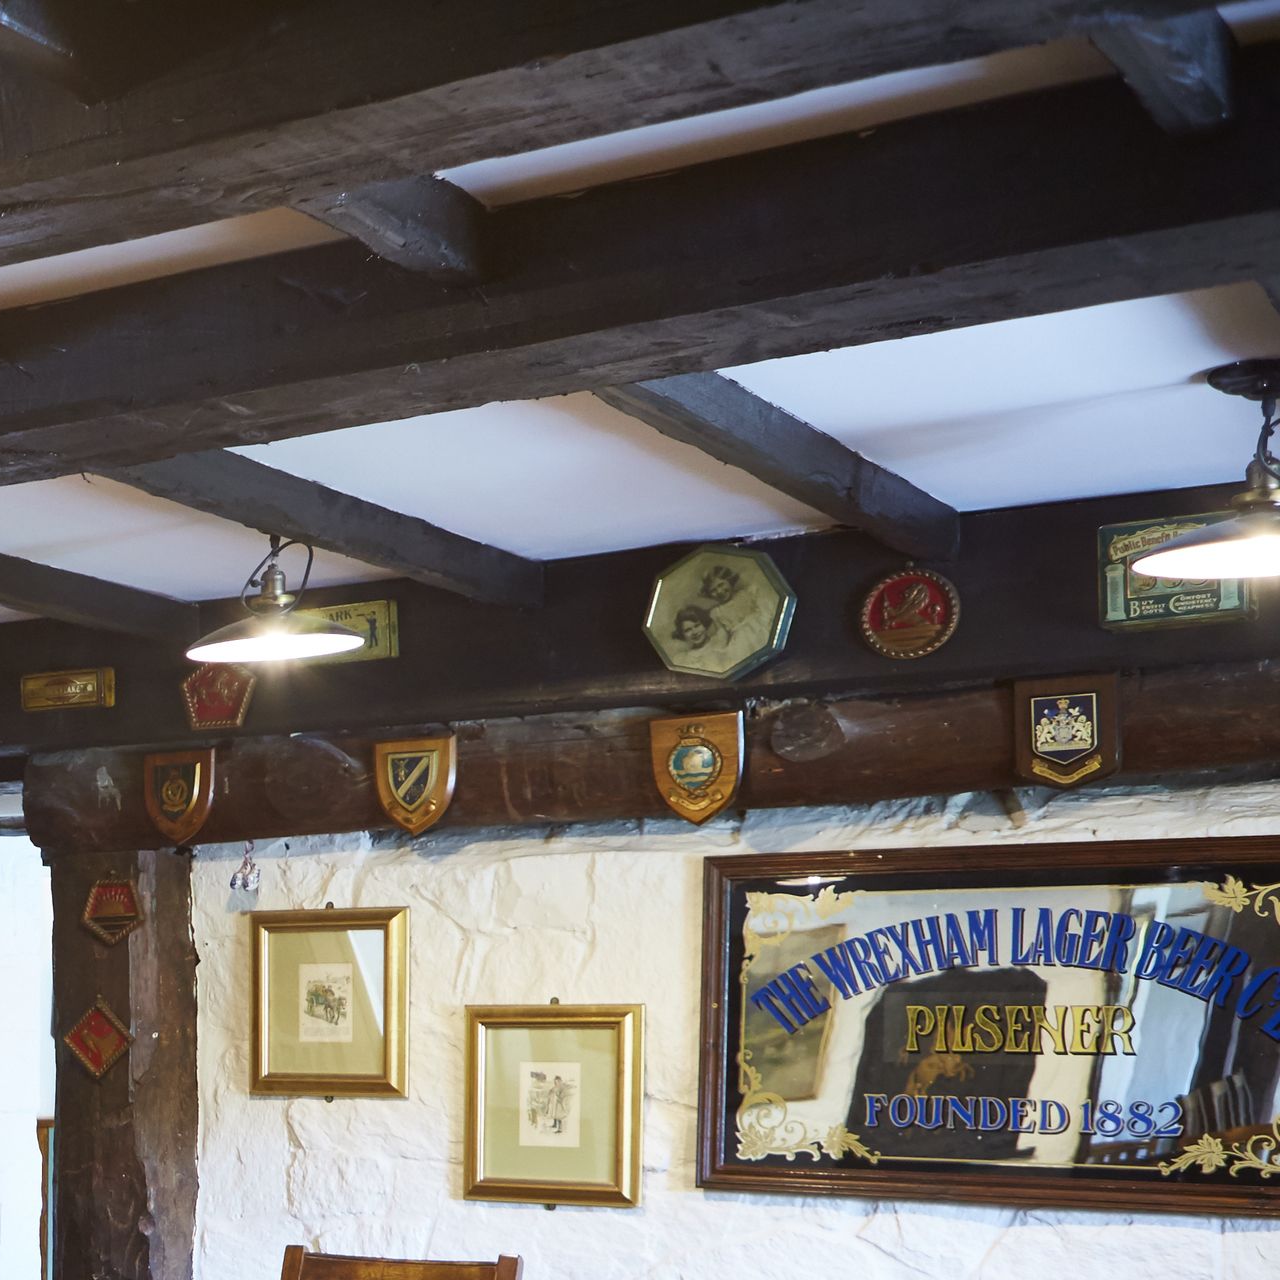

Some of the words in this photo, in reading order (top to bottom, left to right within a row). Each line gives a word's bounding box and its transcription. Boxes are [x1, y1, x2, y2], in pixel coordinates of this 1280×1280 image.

[751, 962, 832, 1035] THE
[810, 908, 999, 1001] WREXHAM
[1010, 907, 1137, 975] LAGER
[1134, 919, 1252, 1008] BEER
[905, 1004, 1137, 1056] PILSENER
[864, 1092, 1070, 1132] FOUNDED
[1080, 1099, 1185, 1138] 1882
